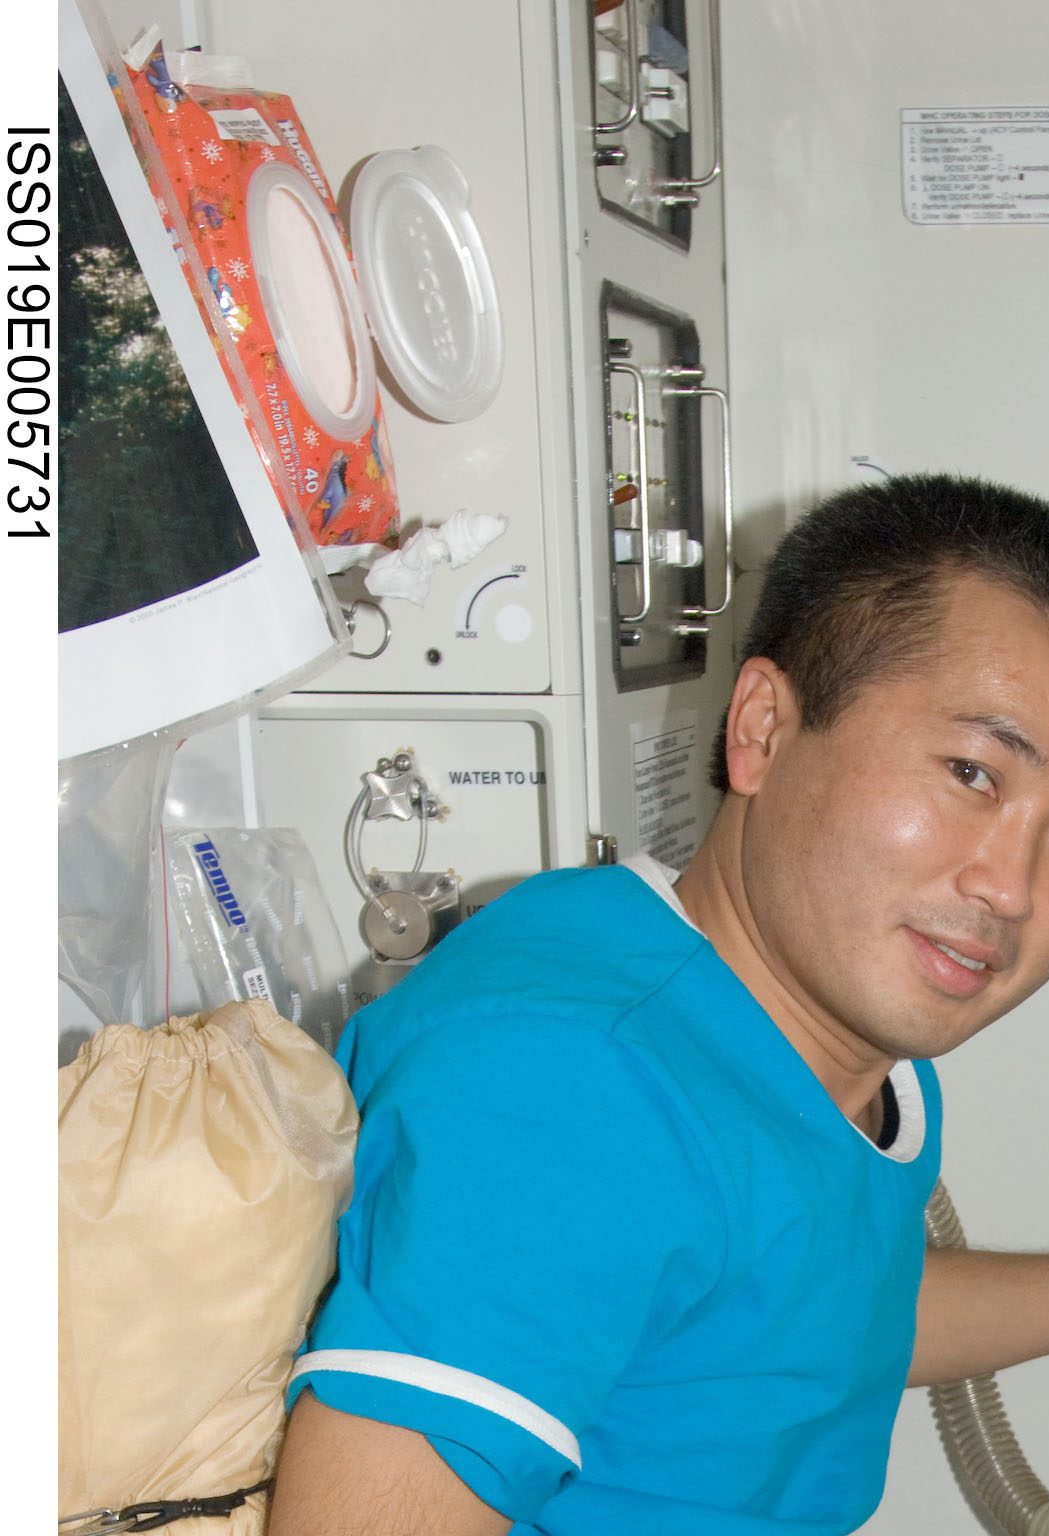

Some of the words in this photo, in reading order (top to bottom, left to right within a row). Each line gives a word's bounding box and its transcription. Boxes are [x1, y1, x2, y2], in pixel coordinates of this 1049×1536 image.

[303, 467, 319, 493] 40
[448, 771, 501, 785] WATER
[504, 771, 526, 785] TO
[193, 833, 247, 927] Tempo
